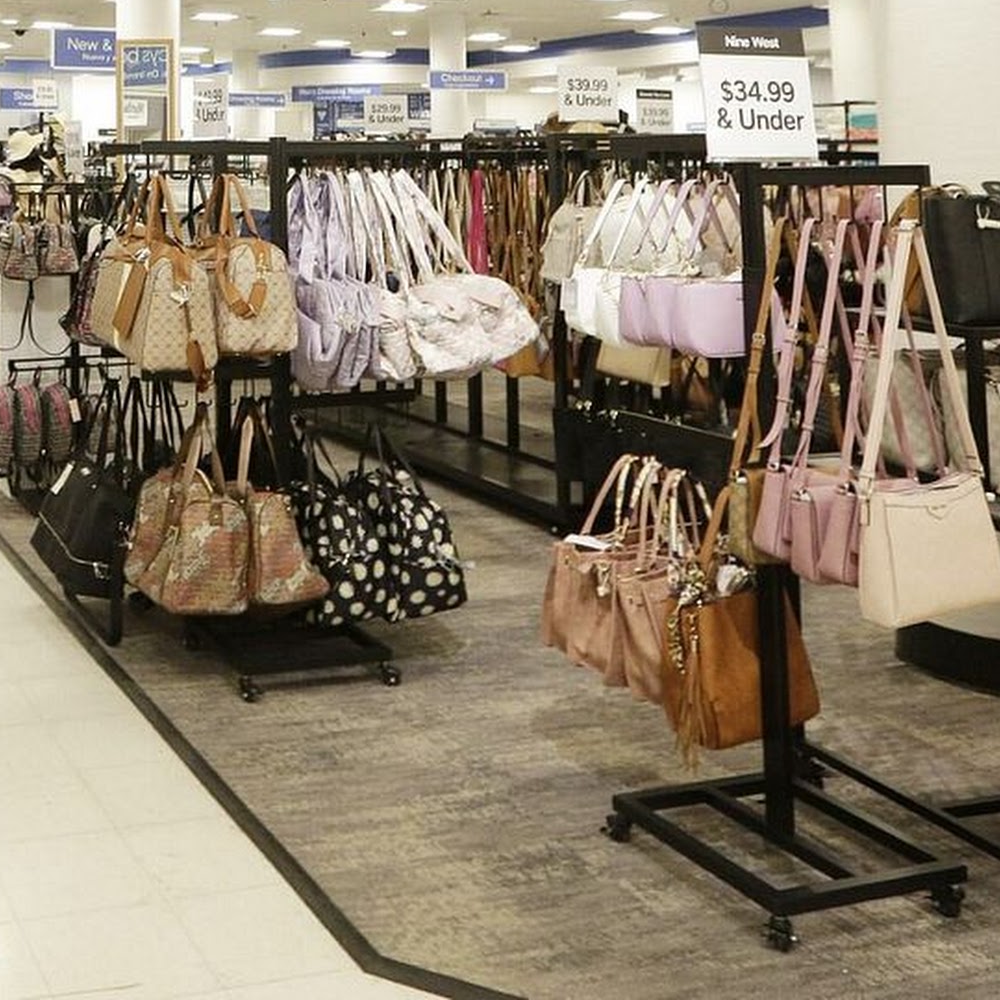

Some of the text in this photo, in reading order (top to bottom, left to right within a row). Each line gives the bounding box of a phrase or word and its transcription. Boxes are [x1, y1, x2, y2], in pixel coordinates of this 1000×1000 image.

[67, 36, 99, 51] New
[724, 34, 780, 49] Nine West
[567, 77, 609, 92] $39.99
[720, 79, 795, 103] $34.99
[564, 94, 613, 108] & Under
[377, 114, 405, 124] Under
[717, 106, 804, 131] & Under
